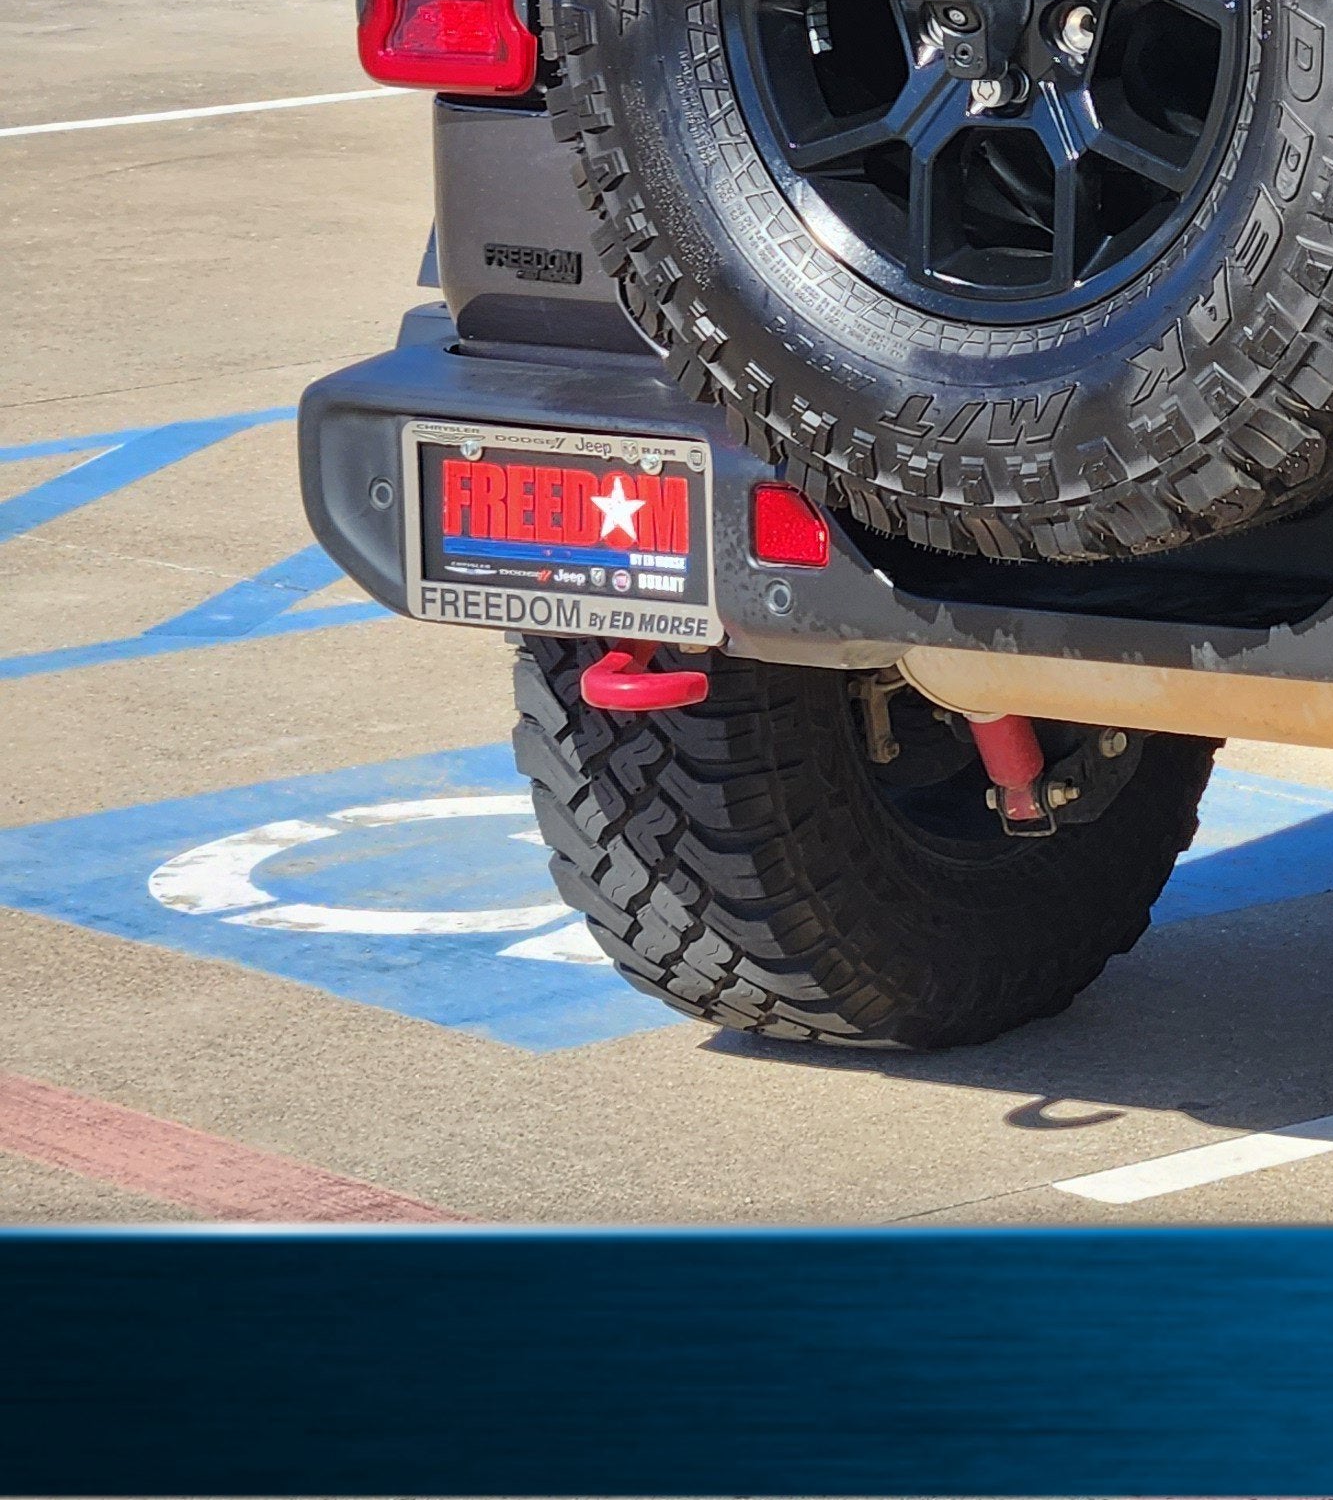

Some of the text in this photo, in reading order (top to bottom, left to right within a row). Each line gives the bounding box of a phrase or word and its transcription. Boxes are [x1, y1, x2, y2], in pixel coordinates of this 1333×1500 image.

[484, 243, 582, 273] FREEDOM
[877, 383, 1081, 446] M/T
[575, 437, 612, 456] Jeep
[641, 447, 676, 456] RAM
[442, 458, 690, 555] FREEDOM
[554, 568, 586, 587] Jeep
[420, 586, 582, 629] FREEDOM
[609, 610, 634, 631] ED
[637, 613, 709, 637] MORSE
